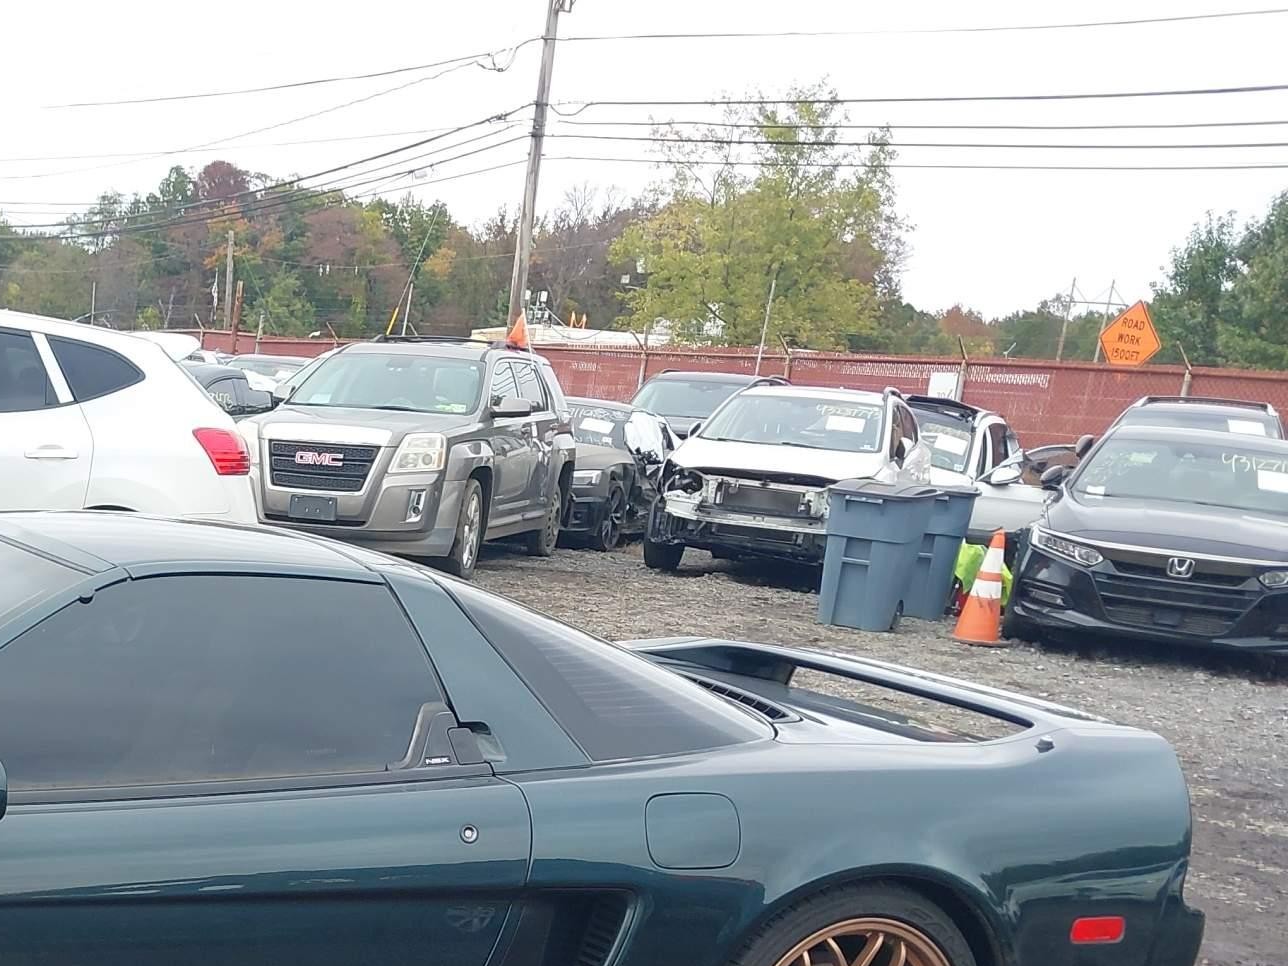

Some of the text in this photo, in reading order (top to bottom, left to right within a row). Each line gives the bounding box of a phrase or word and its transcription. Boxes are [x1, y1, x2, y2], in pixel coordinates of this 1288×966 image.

[1122, 317, 1145, 331] ROAD
[1117, 333, 1142, 346] WORK
[295, 451, 344, 467] GMC
[425, 757, 450, 765] NSX
